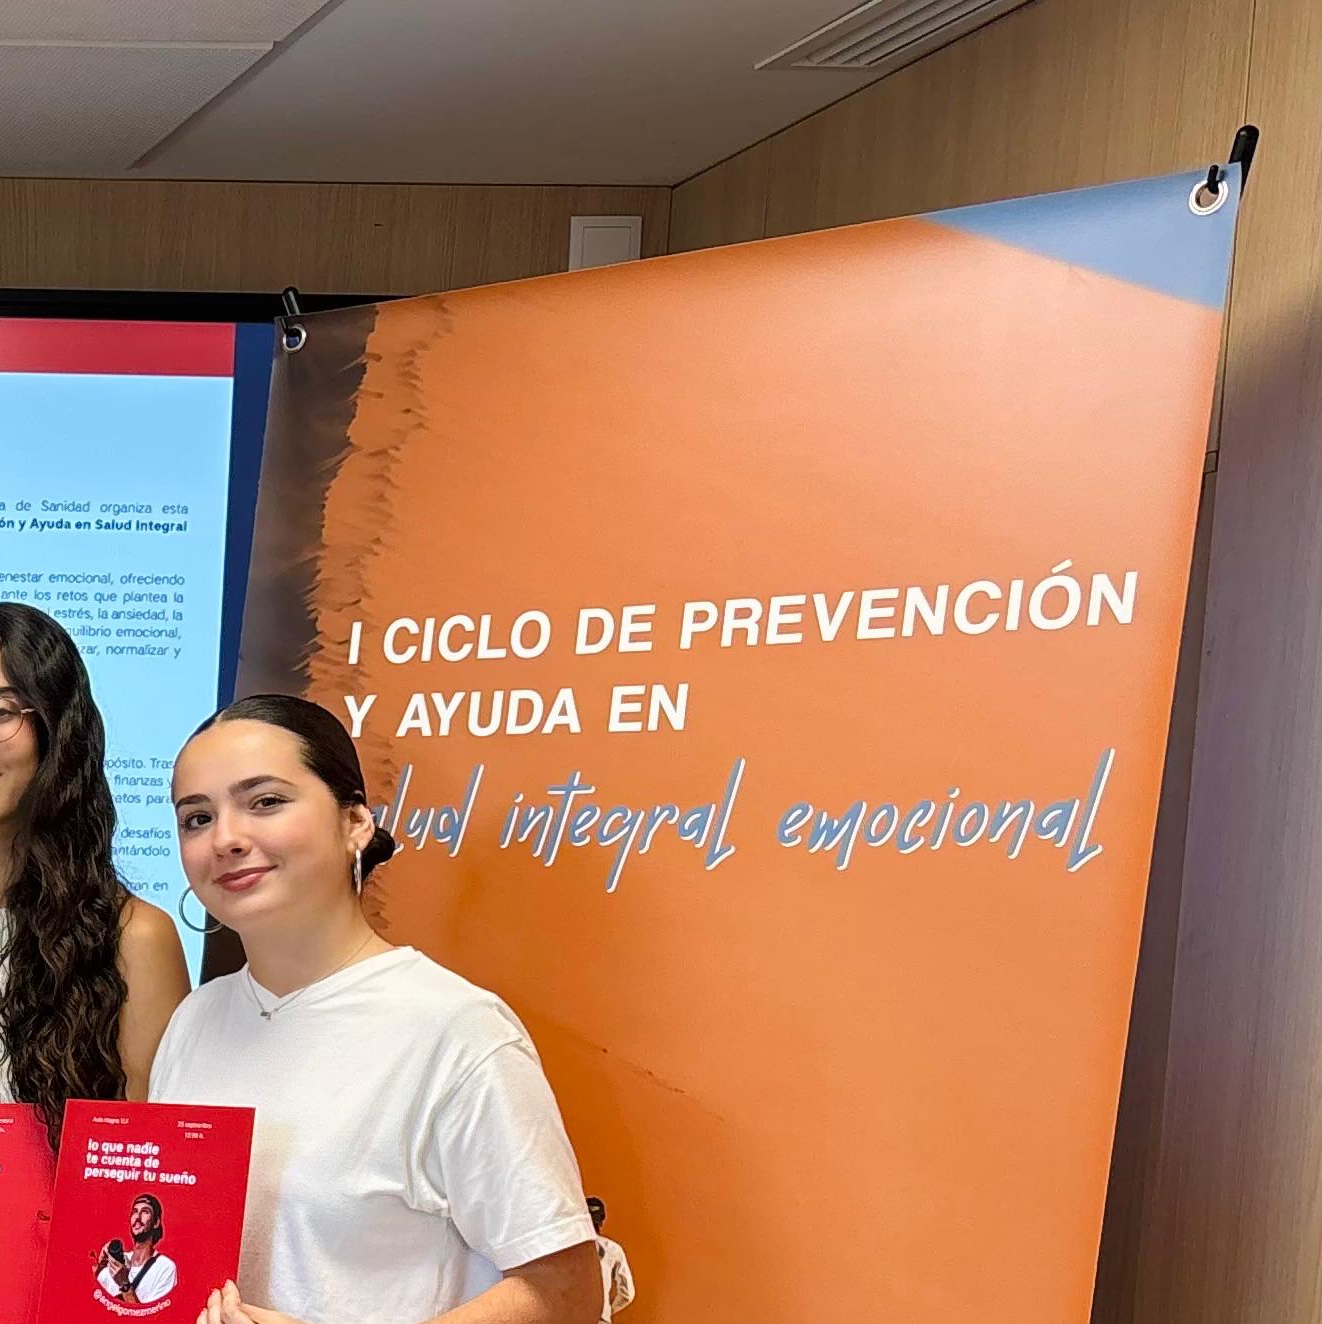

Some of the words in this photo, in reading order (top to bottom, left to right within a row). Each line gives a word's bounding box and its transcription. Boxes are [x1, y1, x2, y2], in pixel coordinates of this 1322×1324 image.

[15, 500, 32, 511] de
[41, 500, 90, 512] Sanidad
[100, 504, 152, 516] organiza
[162, 504, 188, 515] esta
[29, 518, 71, 532] Ayuda
[75, 521, 91, 530] en
[95, 519, 132, 530] Salud
[136, 520, 187, 534] Integral
[48, 572, 114, 585] emocional,
[120, 573, 185, 586] ofreciendo
[347, 621, 364, 665] I
[384, 611, 551, 664] CICLO
[575, 605, 656, 654] DE
[679, 559, 1138, 650] PREVENCIÓN
[344, 695, 377, 738] Y
[396, 688, 581, 737] AYUDA
[608, 683, 689, 732] EN
[498, 757, 746, 894] integral
[776, 747, 1116, 872] emocional
